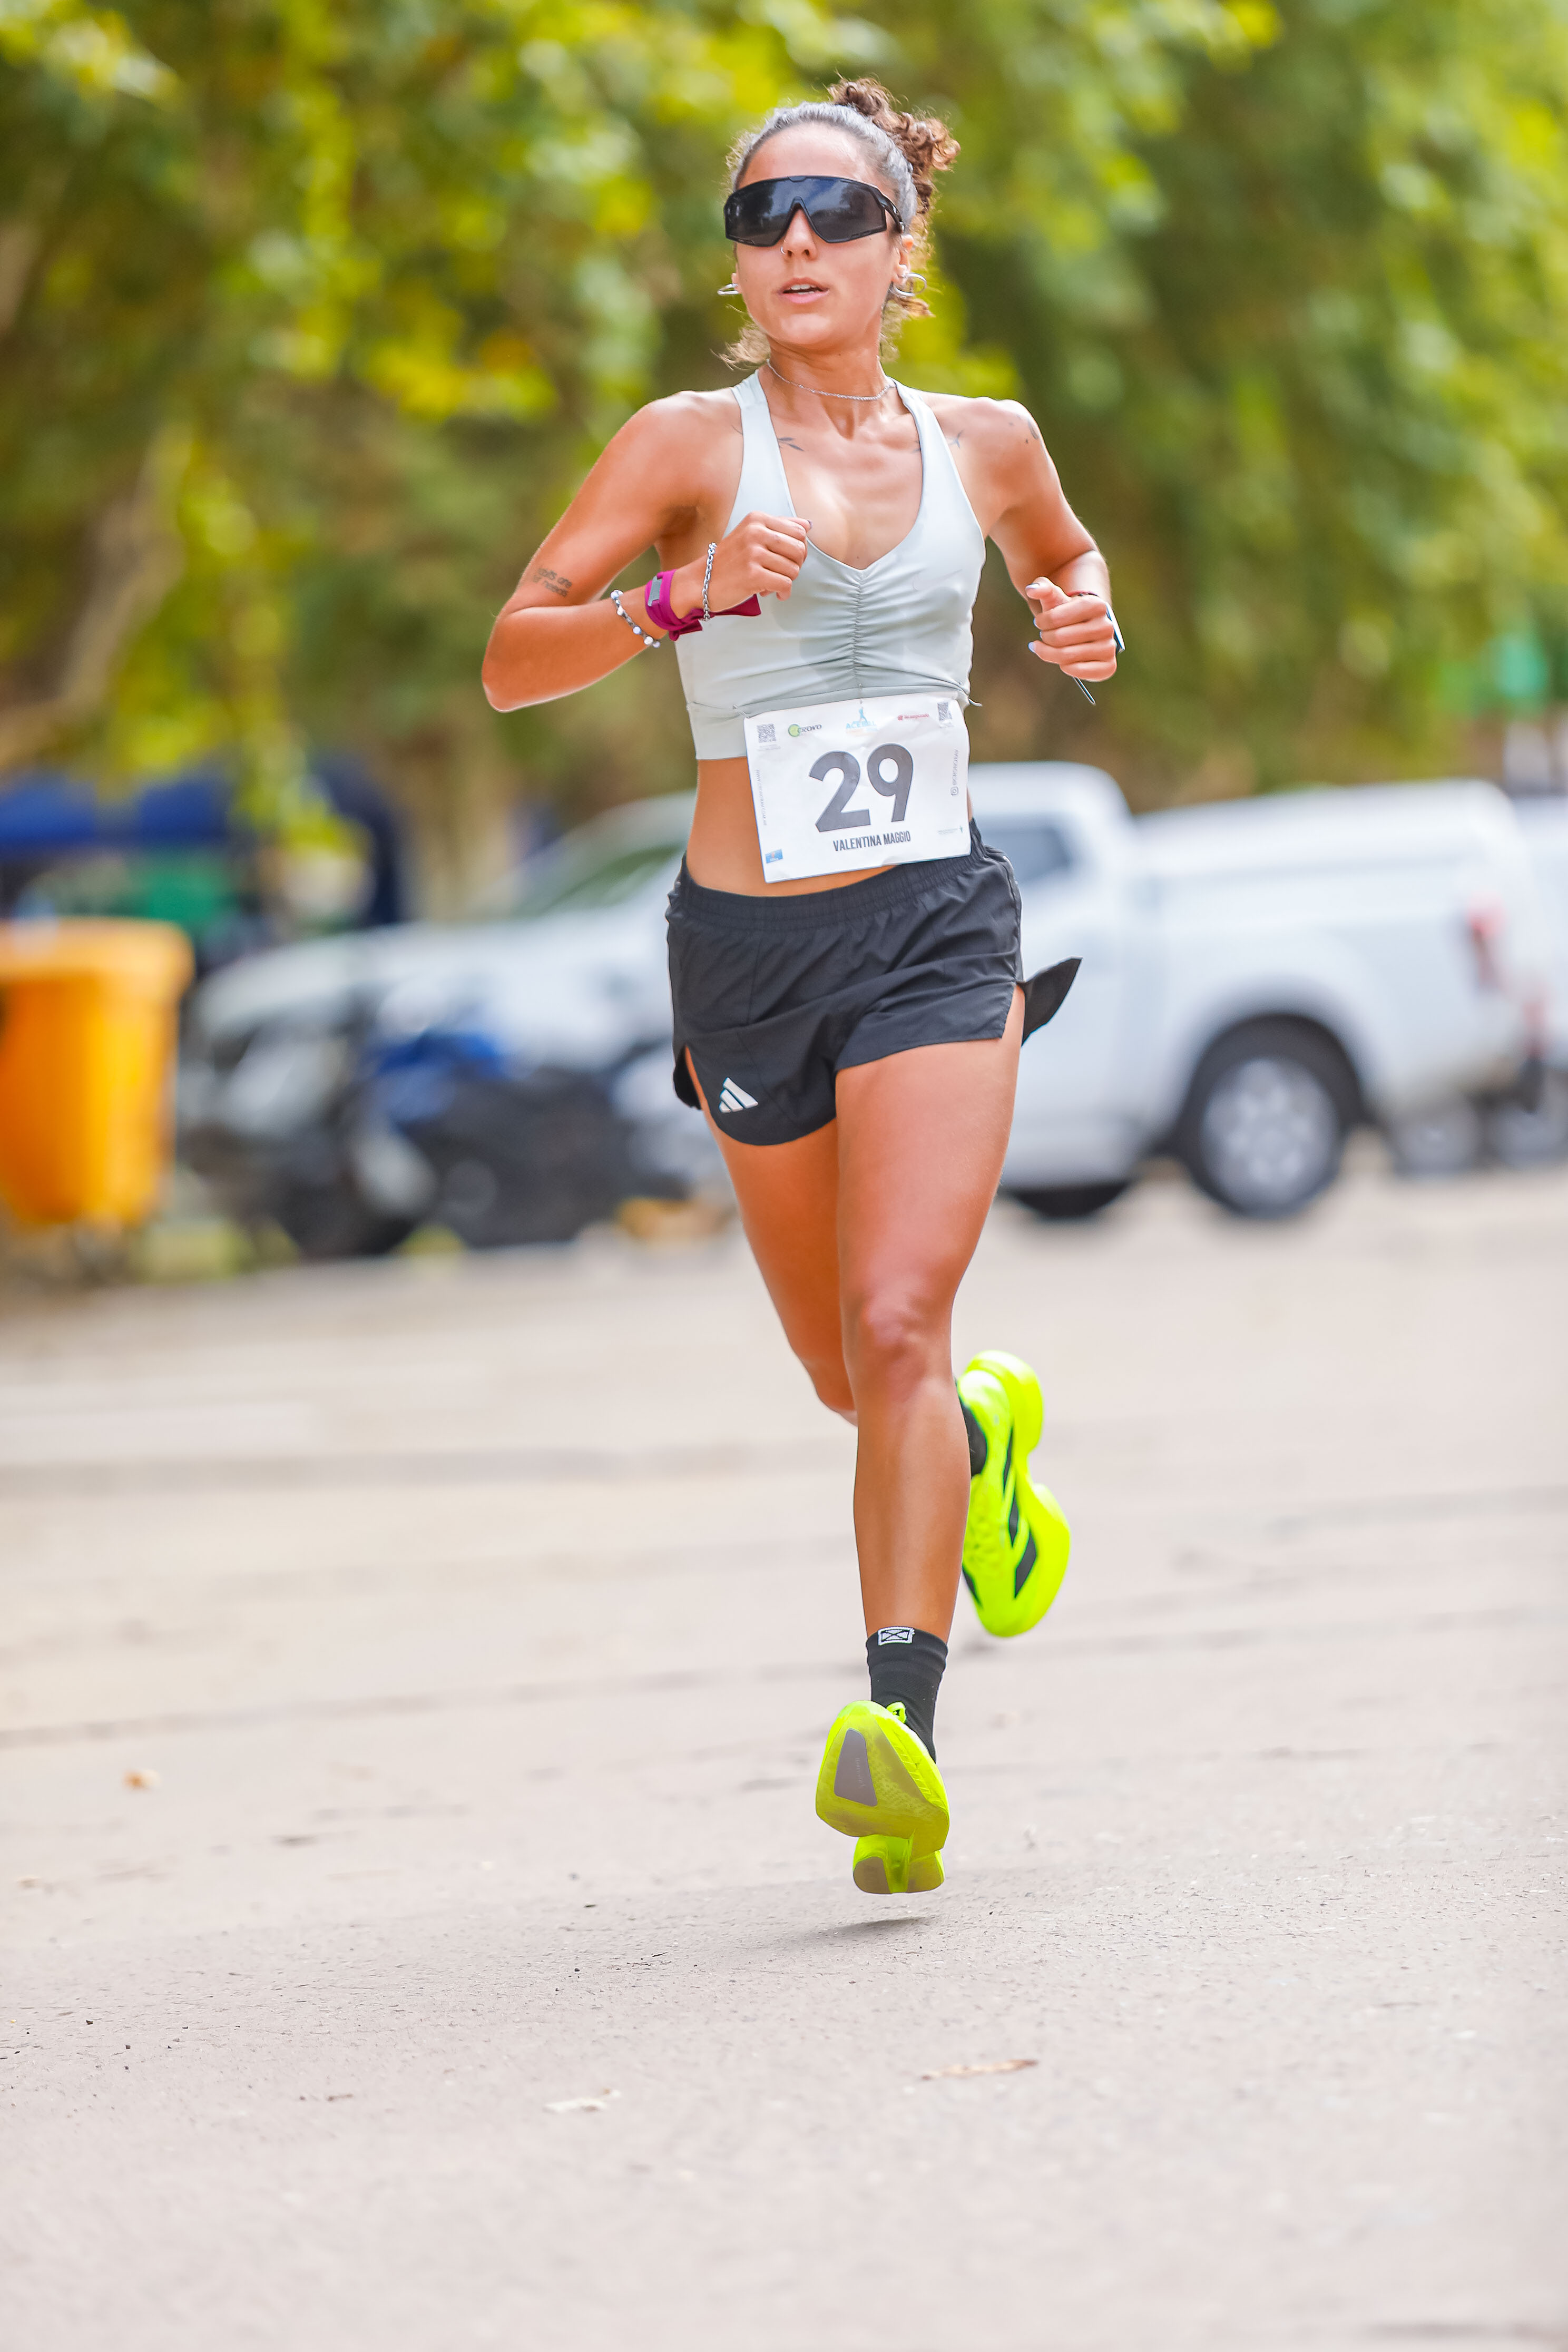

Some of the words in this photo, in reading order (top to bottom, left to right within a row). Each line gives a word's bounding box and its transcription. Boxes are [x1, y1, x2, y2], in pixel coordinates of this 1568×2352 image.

[809, 742, 914, 832] 29
[833, 834, 882, 851] VALENTINA
[883, 830, 911, 845] MAGGIO
